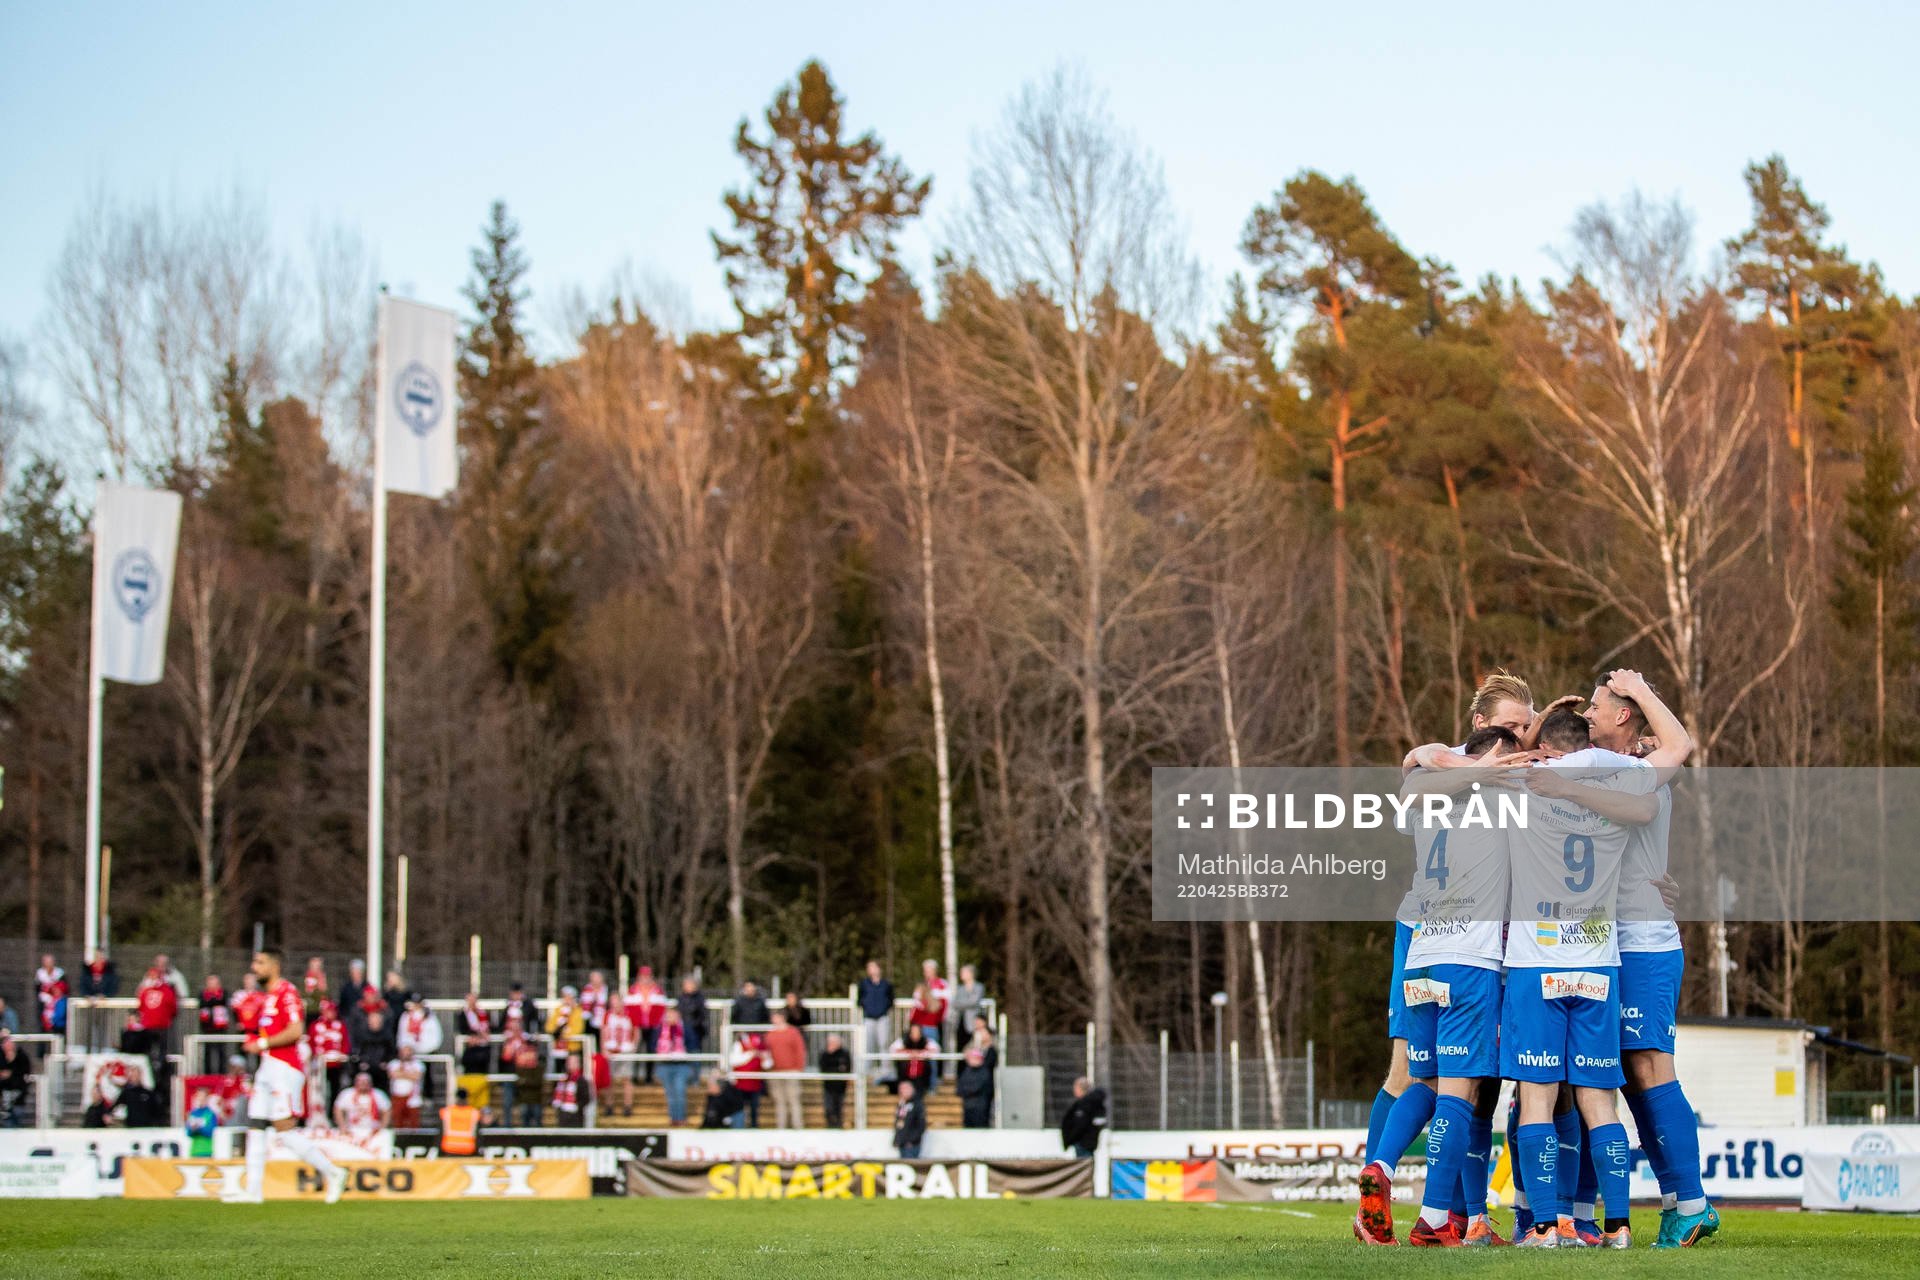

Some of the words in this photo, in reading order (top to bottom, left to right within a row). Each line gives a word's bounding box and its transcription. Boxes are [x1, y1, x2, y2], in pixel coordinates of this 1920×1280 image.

[1425, 829, 1449, 890] 4
[1563, 833, 1595, 893] 9
[1427, 1118, 1450, 1154] office
[1427, 1156, 1439, 1166] 4
[1539, 1135, 1558, 1172] office
[1702, 1140, 1803, 1179] siflo
[296, 1167, 414, 1193] HCO
[1234, 1160, 1334, 1180] Mechanical
[1537, 1174, 1554, 1184] 4
[1609, 1168, 1628, 1179] 4
